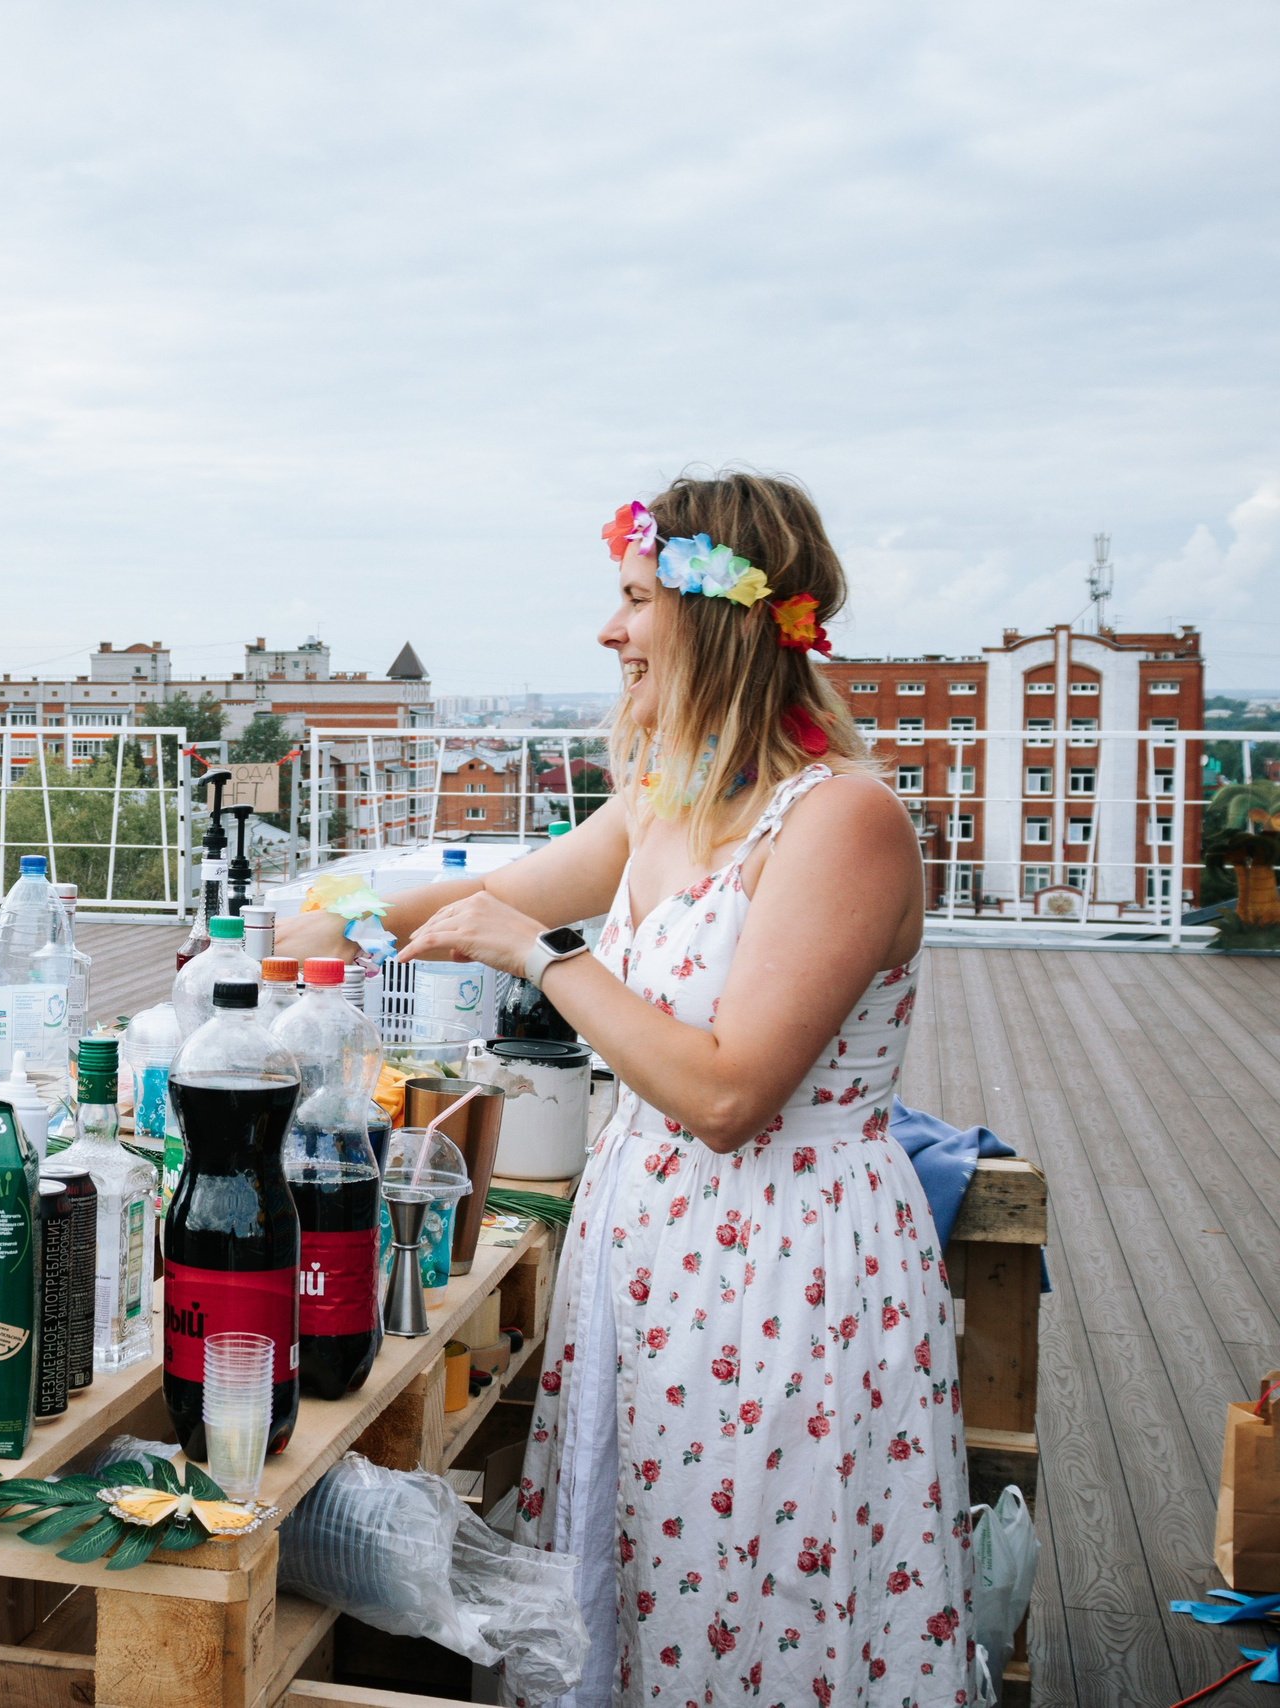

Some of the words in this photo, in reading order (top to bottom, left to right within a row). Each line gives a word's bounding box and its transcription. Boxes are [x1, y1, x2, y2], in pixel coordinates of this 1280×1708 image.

[222, 782, 264, 806] НЕТ
[44, 1219, 61, 1322] УПОТРЕБЛЕНИЕ
[58, 1276, 68, 1318] ВАШЕМУ
[57, 1321, 67, 1357] ВРЕДИТ
[42, 1325, 58, 1412] ЧРЕЗМЕРНОЕ
[56, 1356, 66, 1408] АЛКОГОЛЯ
